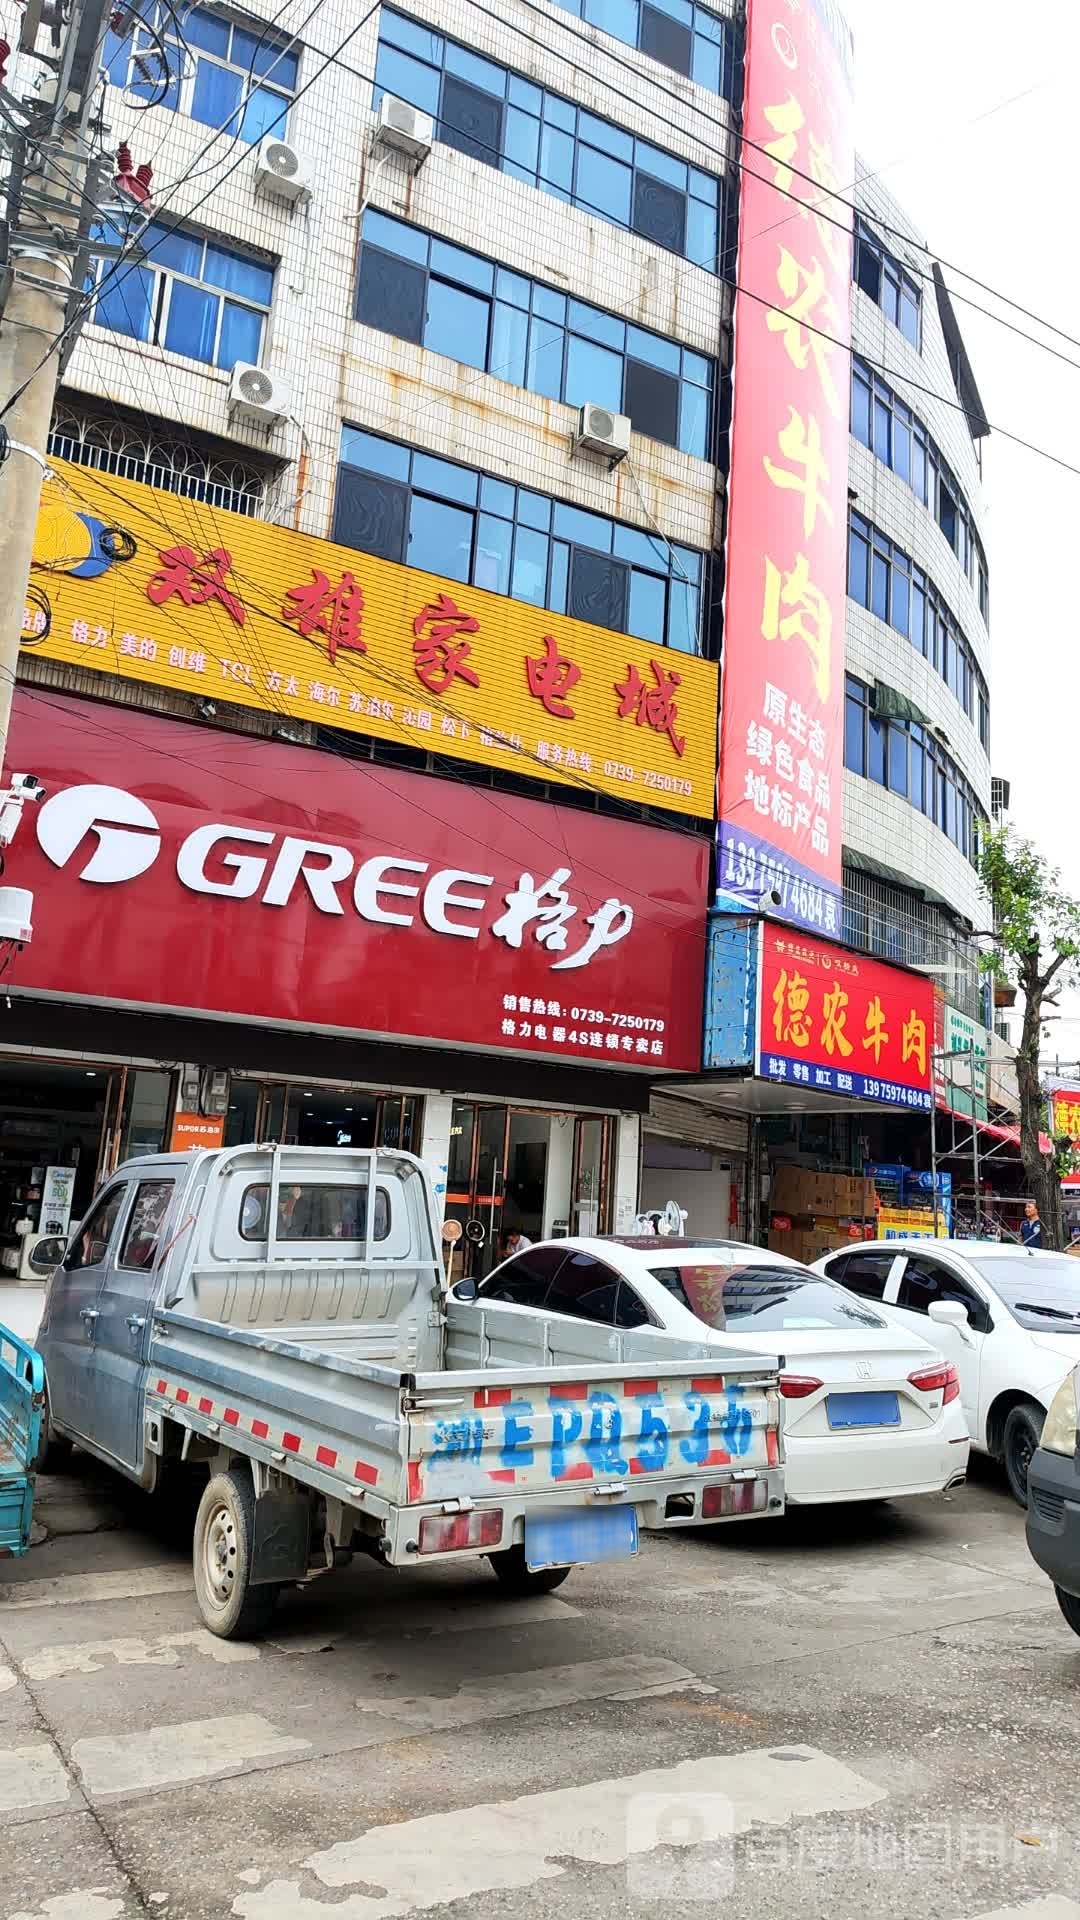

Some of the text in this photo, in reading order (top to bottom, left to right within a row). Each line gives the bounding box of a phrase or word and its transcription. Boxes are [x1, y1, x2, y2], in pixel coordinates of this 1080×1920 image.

[147, 544, 686, 758] 双雄家电城
[72, 618, 108, 648] 格力
[119, 633, 157, 661] 美的
[168, 645, 207, 673] 创维
[220, 658, 254, 685] TCL
[266, 670, 299, 697] 方太
[308, 680, 341, 707] 海尔
[348, 691, 394, 721] 苏泊尔
[401, 706, 432, 731] 沁园
[441, 714, 471, 740] 松下
[603, 760, 693, 797] 0739-7250179
[762, 681, 827, 761] 原生态
[744, 769, 830, 856] 地标产品
[745, 720, 831, 813] 绿色食品
[177, 823, 634, 970] GREE 格力
[772, 968, 927, 1078] 德农牛肉
[769, 1058, 786, 1077] 批发
[793, 1063, 810, 1082] 零售
[816, 1068, 831, 1086] 加工
[837, 1073, 853, 1091] 配送
